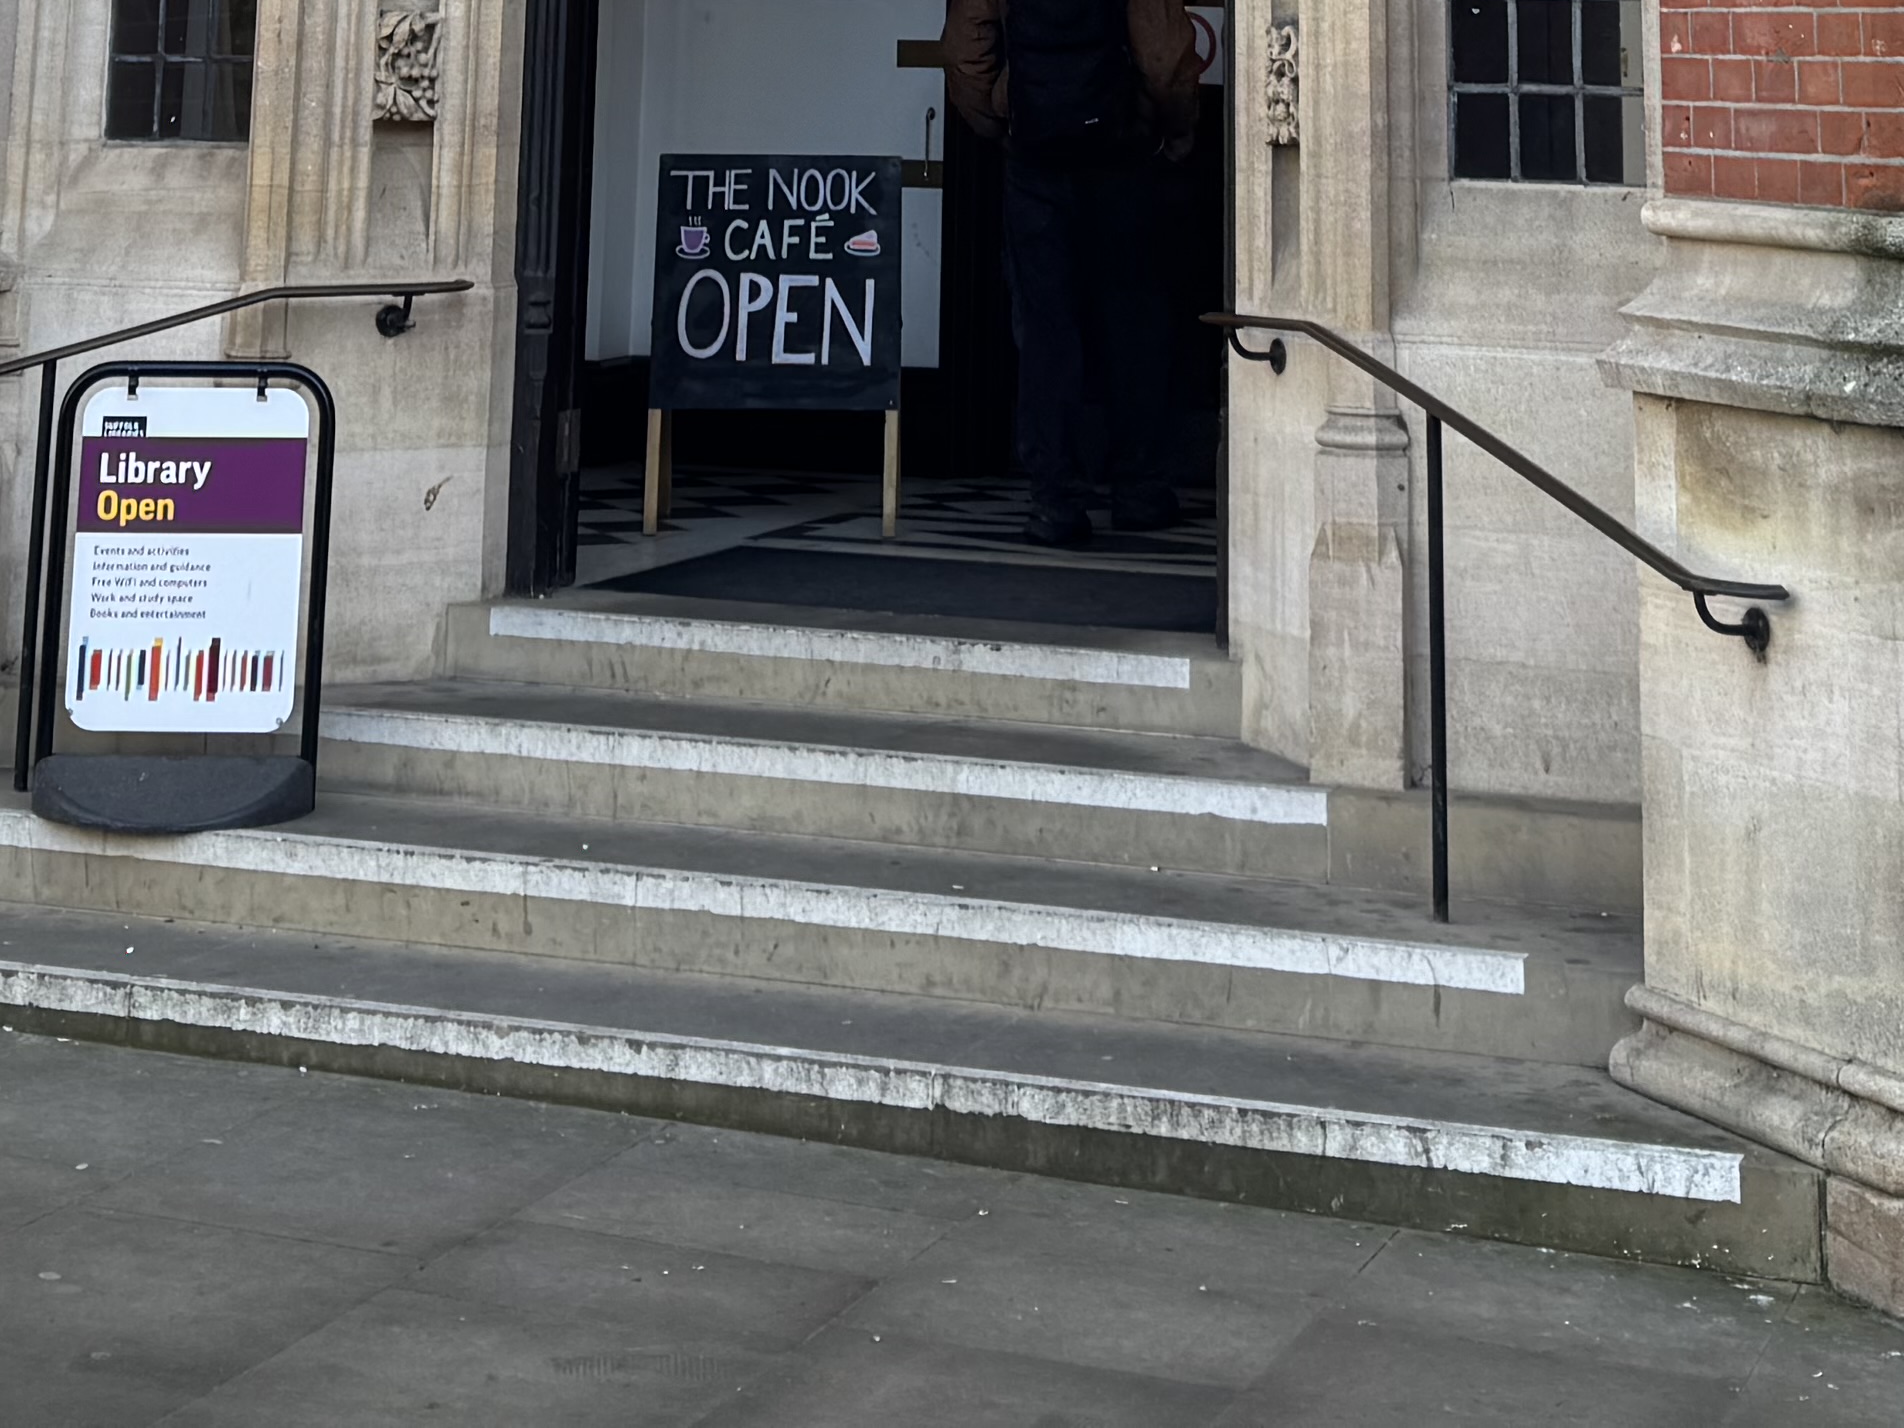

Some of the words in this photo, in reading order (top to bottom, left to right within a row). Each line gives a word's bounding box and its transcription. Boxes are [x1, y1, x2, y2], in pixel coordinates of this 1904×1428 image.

[670, 169, 752, 210] THE
[768, 168, 878, 216] NOOK
[724, 213, 834, 261] CAFÉ
[677, 268, 875, 366] OPEN
[100, 452, 211, 490] Library
[97, 490, 175, 526] Open
[94, 545, 125, 556] Events
[128, 546, 144, 556] and
[148, 546, 190, 556] activities
[92, 562, 148, 571] Information
[150, 562, 168, 571] and
[170, 562, 211, 572] guidance
[92, 576, 112, 586] Free
[140, 577, 156, 587] and
[158, 579, 207, 588] computers
[91, 592, 116, 602] Work
[119, 593, 136, 602] and
[139, 593, 164, 604] study
[168, 596, 193, 604] space
[90, 608, 118, 618] Books
[121, 608, 138, 618] and
[140, 610, 206, 618] entertainment
